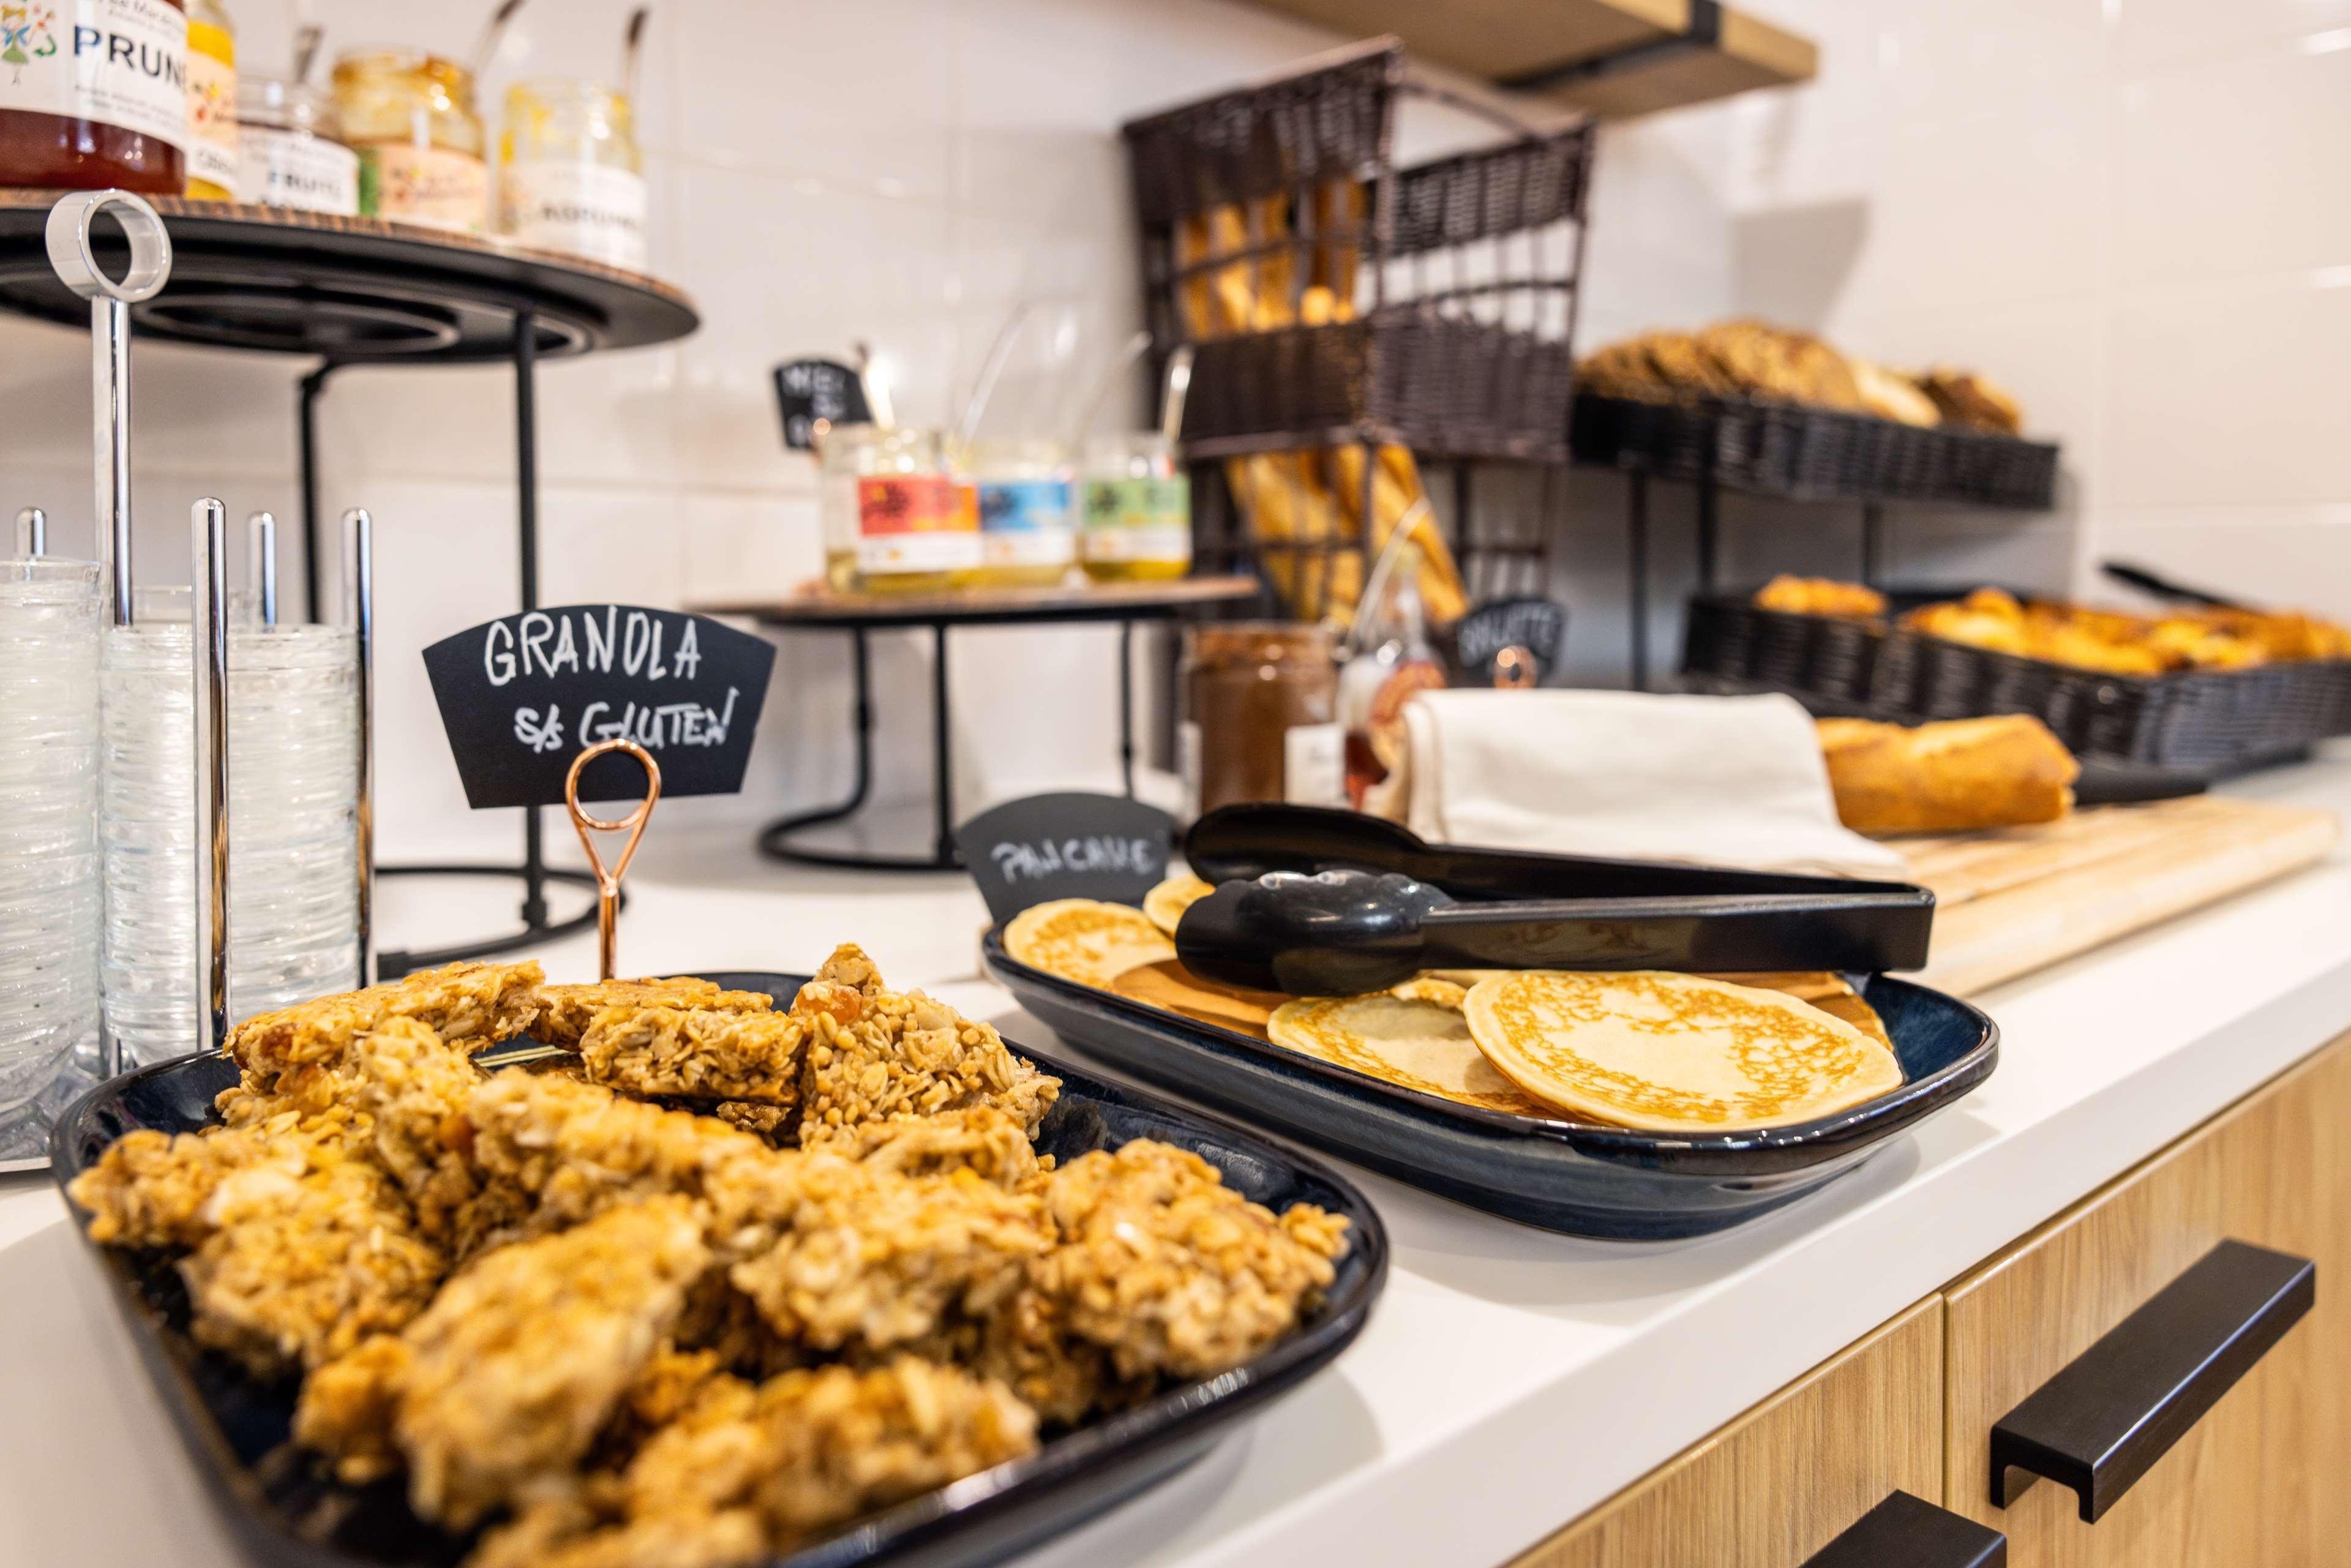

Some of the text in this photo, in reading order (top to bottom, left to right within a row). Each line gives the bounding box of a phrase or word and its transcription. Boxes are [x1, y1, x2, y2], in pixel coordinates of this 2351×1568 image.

[74, 24, 186, 96] PRUN
[485, 605, 701, 686] GRANOLA
[579, 686, 740, 749] GLUTEN
